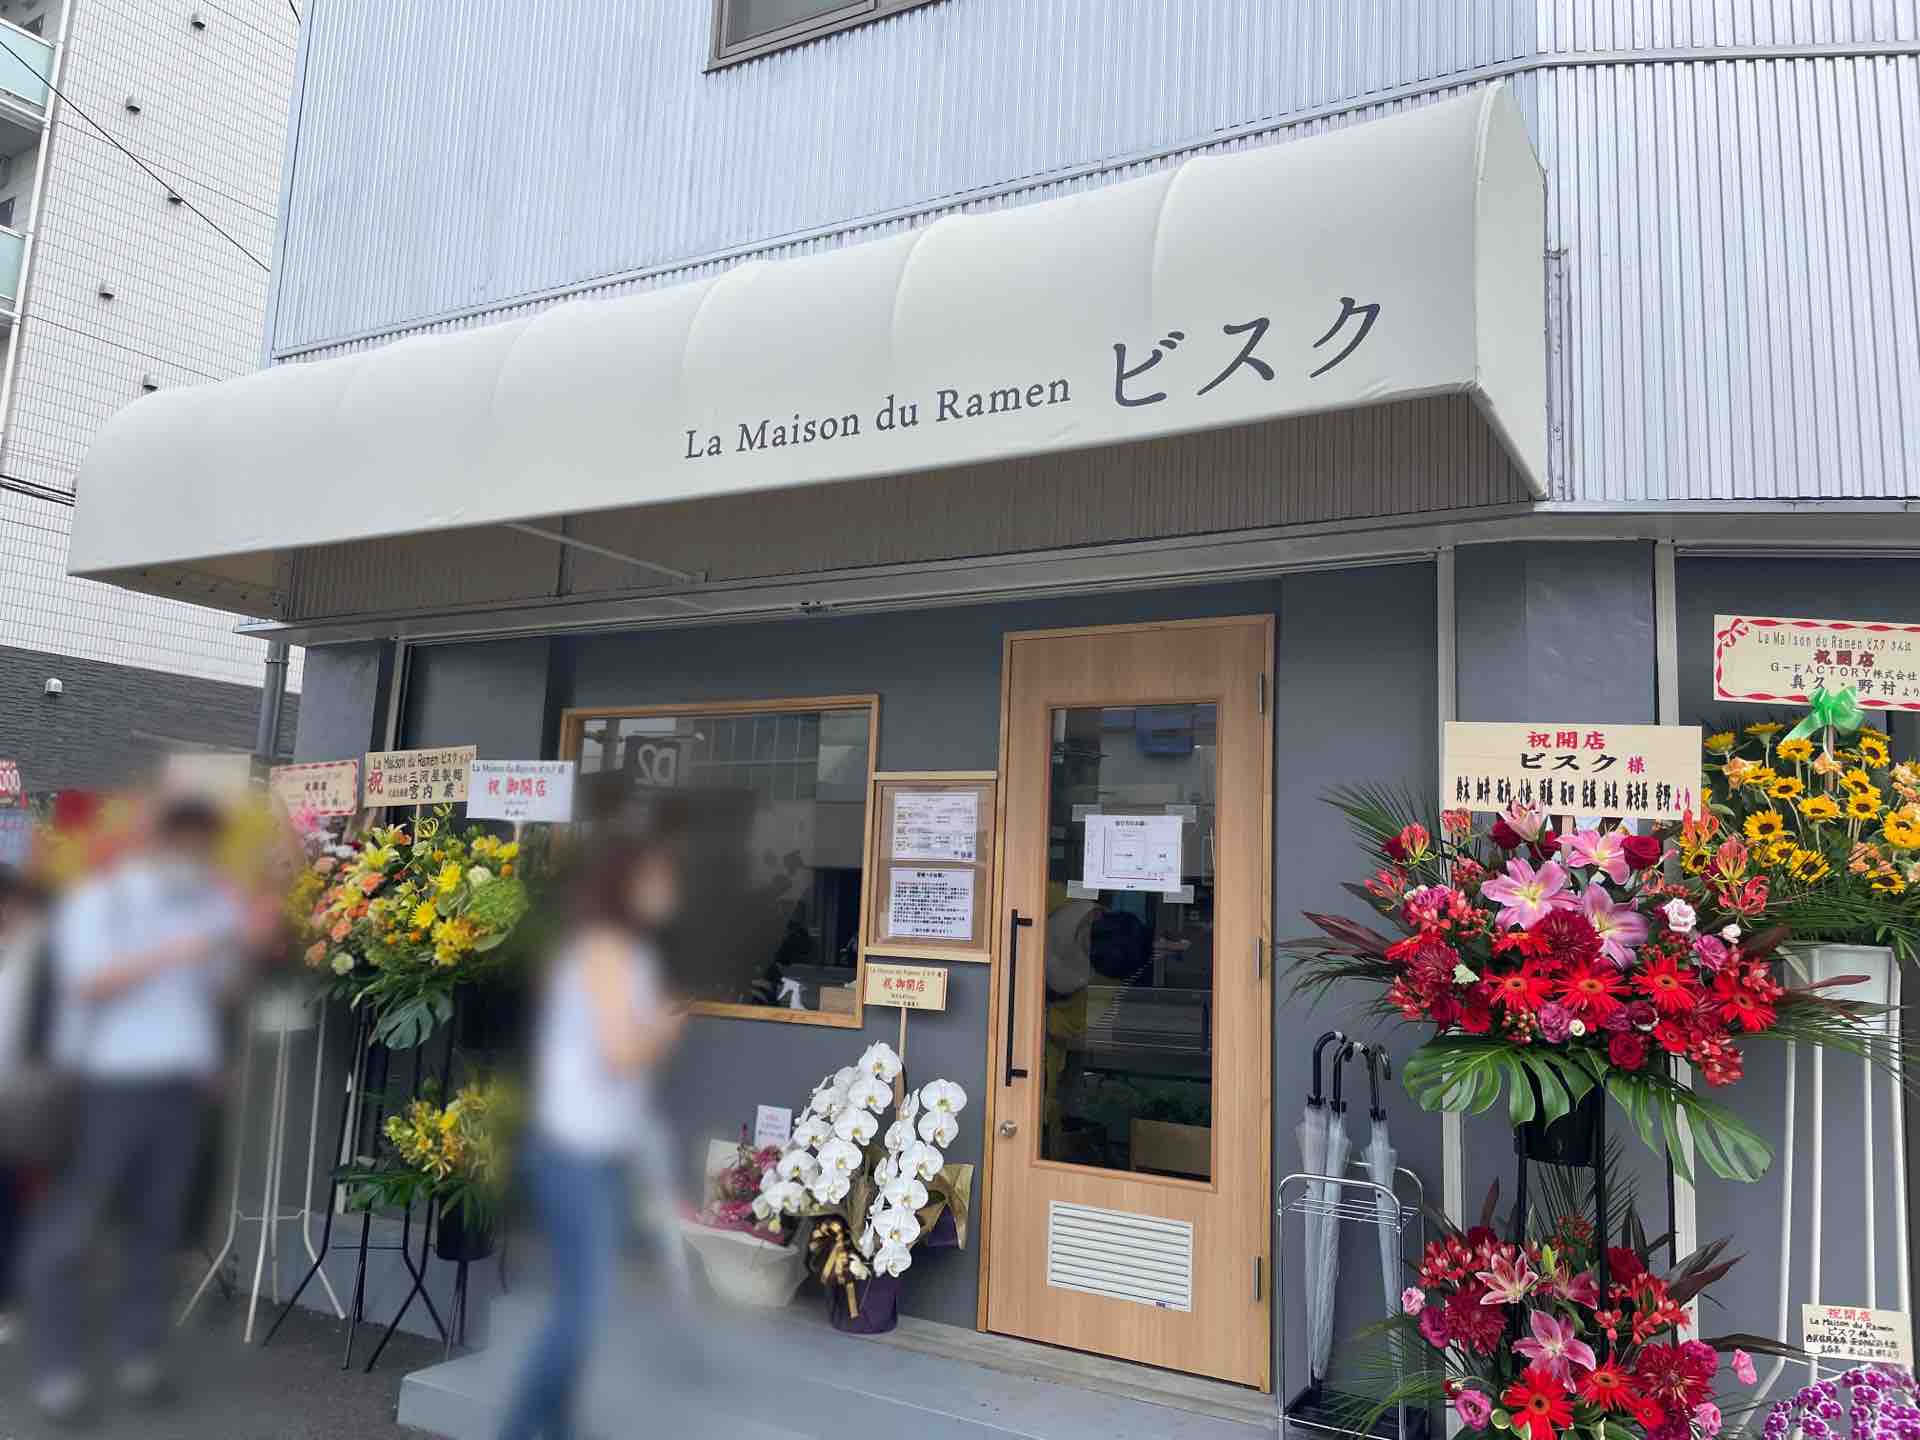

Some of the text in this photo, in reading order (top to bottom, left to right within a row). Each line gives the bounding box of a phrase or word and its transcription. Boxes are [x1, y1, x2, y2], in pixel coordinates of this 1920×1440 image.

[684, 296, 1381, 460] La Maison du Ramen ビスク
[1758, 631, 1769, 644] La
[1815, 636, 1828, 649] du
[1831, 635, 1863, 650] Ramen
[1813, 649, 1875, 668] 祝開店
[1527, 731, 1606, 750] 祝開店
[367, 770, 384, 795] 祝
